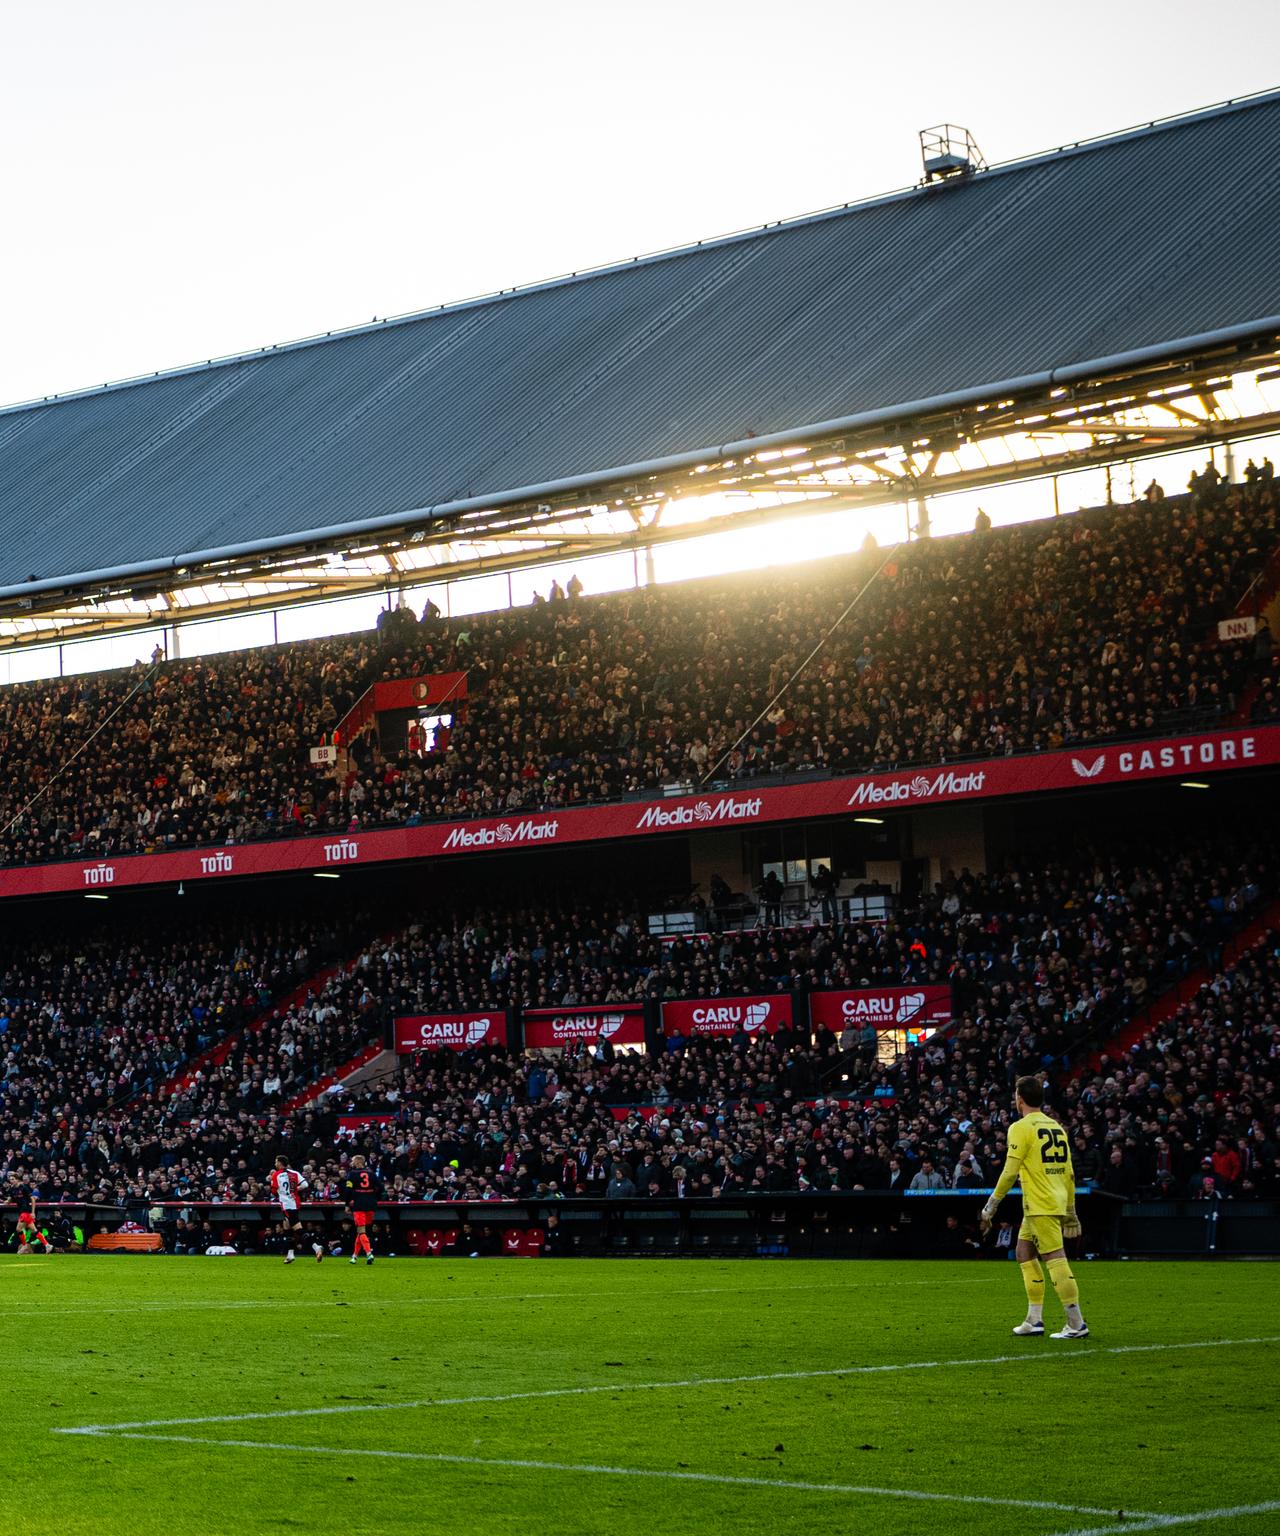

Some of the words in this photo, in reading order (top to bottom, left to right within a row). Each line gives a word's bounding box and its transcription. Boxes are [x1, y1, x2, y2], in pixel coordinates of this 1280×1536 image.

[317, 749, 329, 759] BB
[1119, 737, 1256, 772] CASTORE
[323, 840, 357, 861] TOTO
[200, 852, 233, 873] TOTO
[83, 864, 114, 884] TOTO
[693, 1006, 741, 1024] CARU
[842, 998, 895, 1015] CARU
[421, 1022, 465, 1039] CARU
[552, 1016, 598, 1031] CARU
[1037, 1128, 1069, 1163] 25
[360, 1172, 370, 1188] 3
